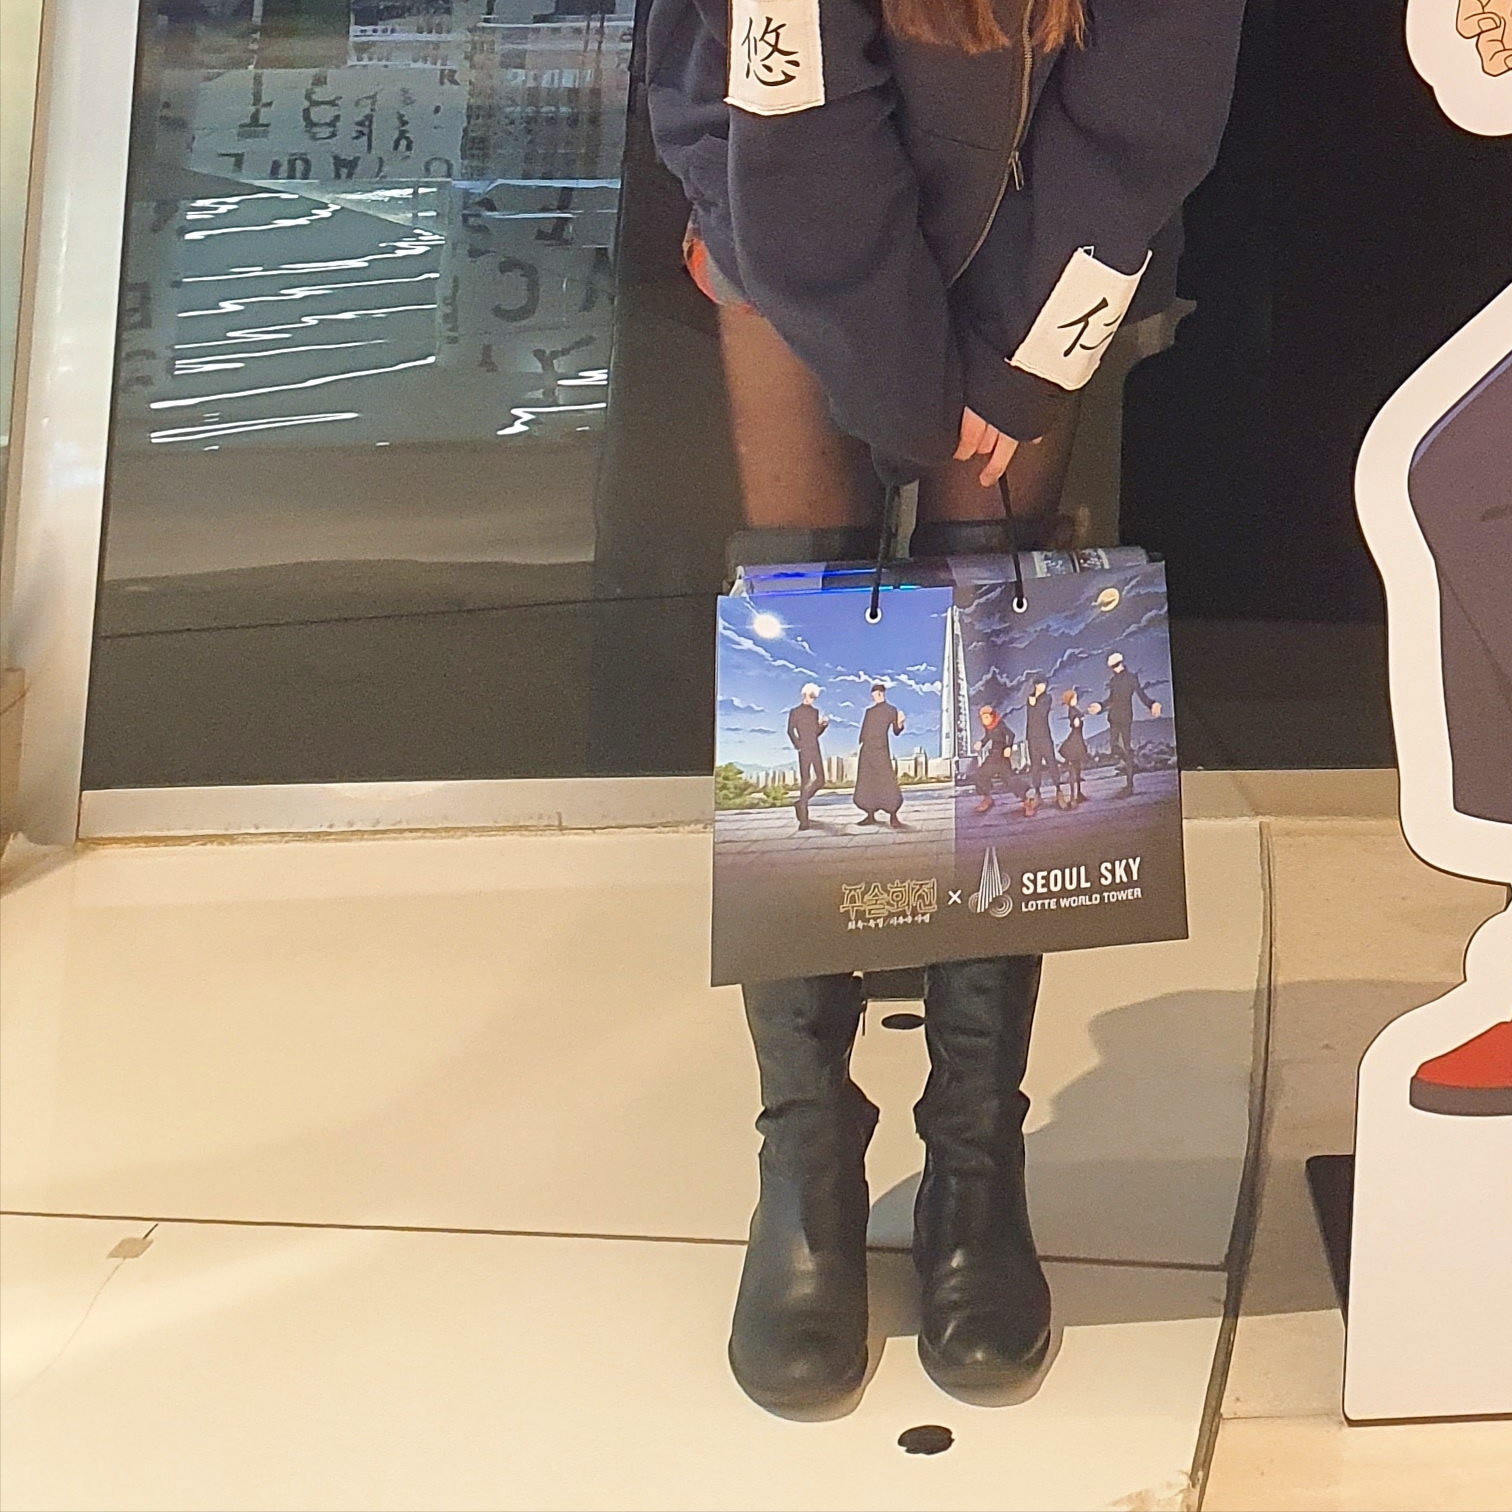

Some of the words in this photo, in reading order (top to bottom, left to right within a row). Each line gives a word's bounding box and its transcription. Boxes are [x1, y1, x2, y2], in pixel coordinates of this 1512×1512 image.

[741, 15, 801, 87] 悠
[1021, 865, 1091, 896] SEOUL
[1100, 856, 1142, 886] SKY
[840, 877, 937, 921] 주술회전
[1021, 899, 1057, 913] LOTTE
[1059, 893, 1101, 909] WORLD
[1102, 887, 1143, 903] TOWER
